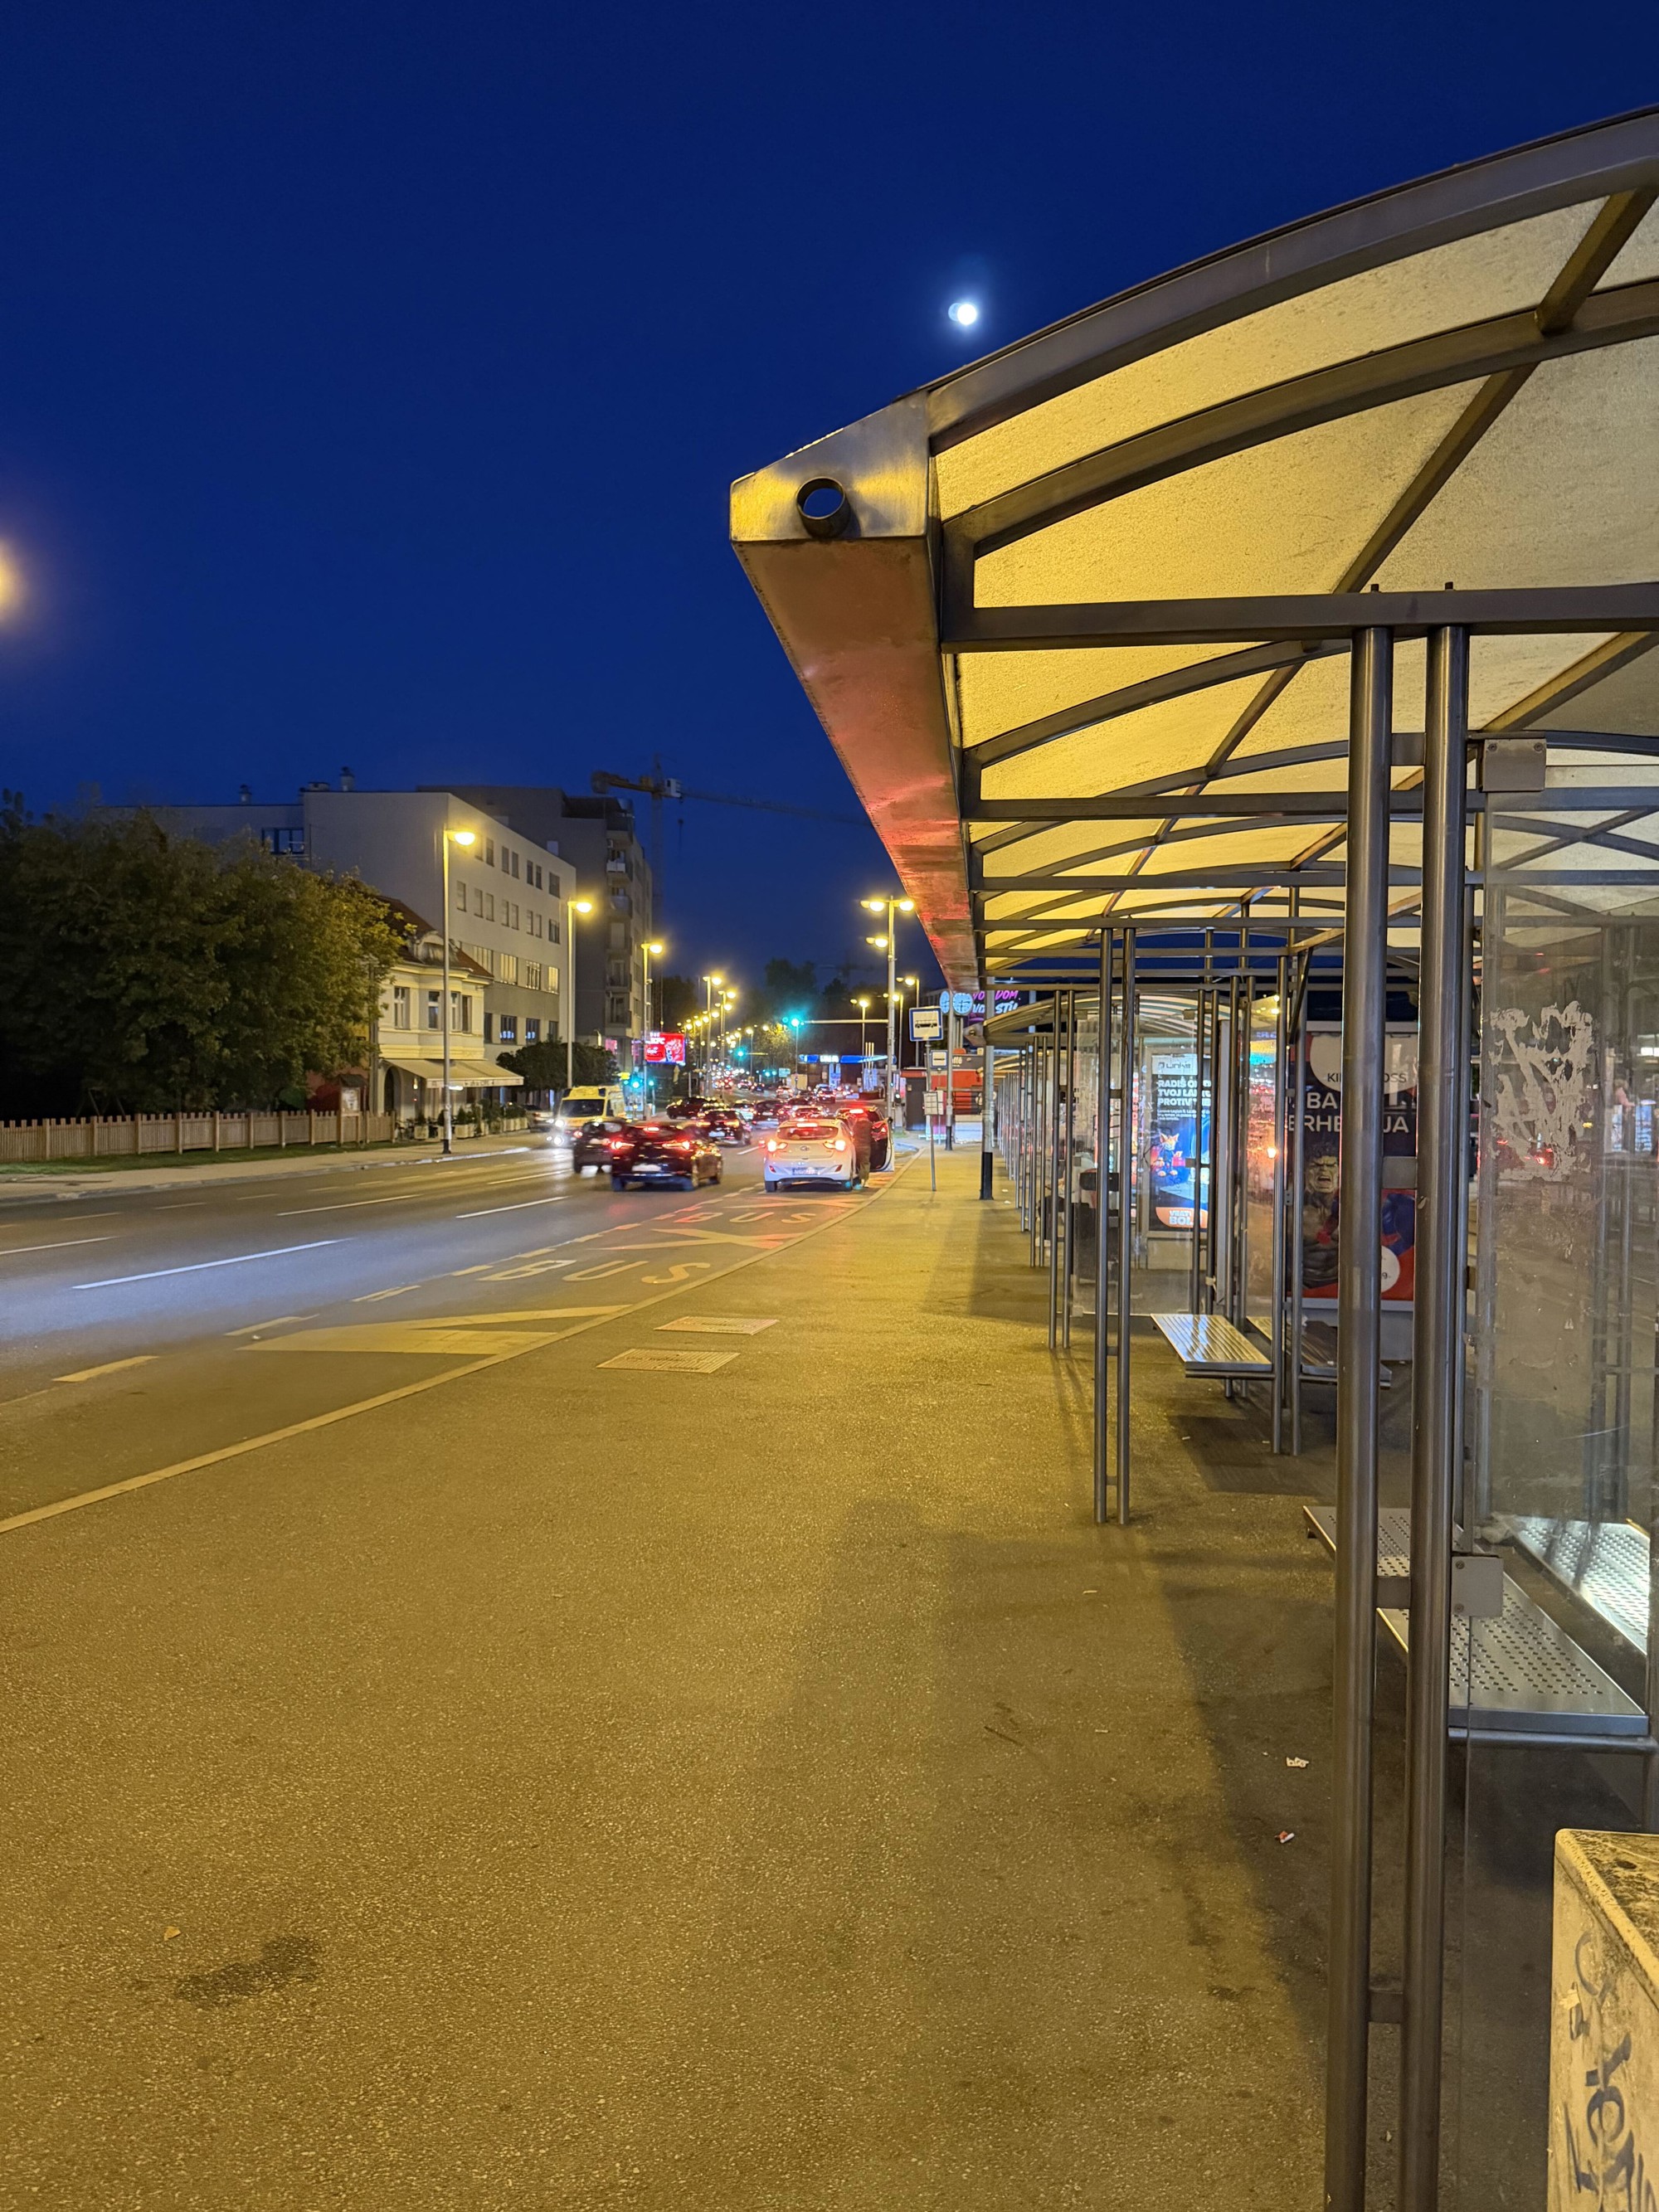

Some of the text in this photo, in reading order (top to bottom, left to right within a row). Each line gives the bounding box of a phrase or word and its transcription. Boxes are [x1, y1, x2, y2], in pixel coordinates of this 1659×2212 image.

[1158, 1076, 1186, 1088] RADIŠ
[1158, 1089, 1181, 1097] TVOJ
[673, 1211, 816, 1223] BUS
[474, 1260, 711, 1284] BUS
